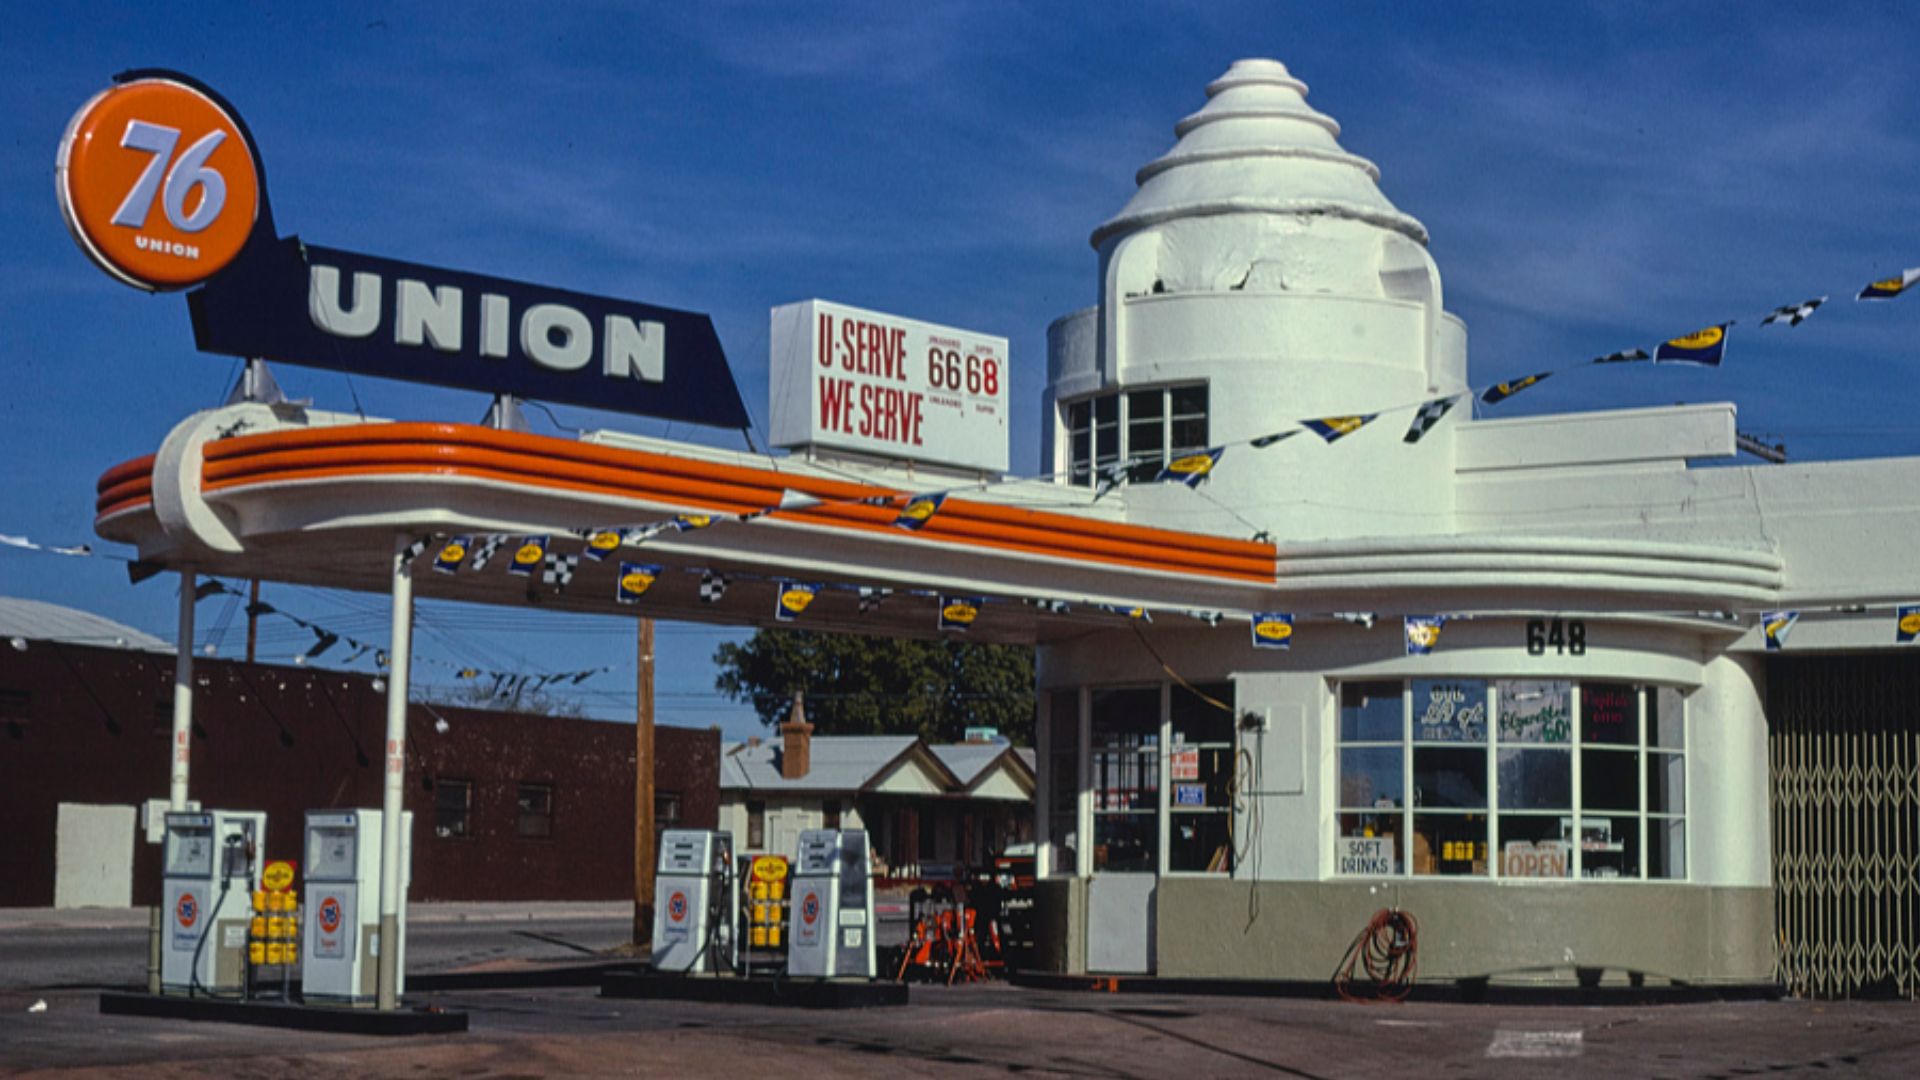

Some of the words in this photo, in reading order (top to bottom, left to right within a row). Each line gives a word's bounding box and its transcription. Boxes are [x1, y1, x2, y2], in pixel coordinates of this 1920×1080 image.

[111, 119, 227, 232] 76
[135, 235, 200, 259] UNION
[308, 263, 665, 383] UNION
[928, 346, 961, 391] 66
[966, 353, 998, 397] 68
[819, 376, 855, 434] WE
[859, 384, 924, 446] SERVE
[1526, 619, 1586, 657] 648
[1342, 856, 1388, 874] DRINKS
[1349, 840, 1381, 856] SOFT
[1508, 851, 1565, 877] OPEN
